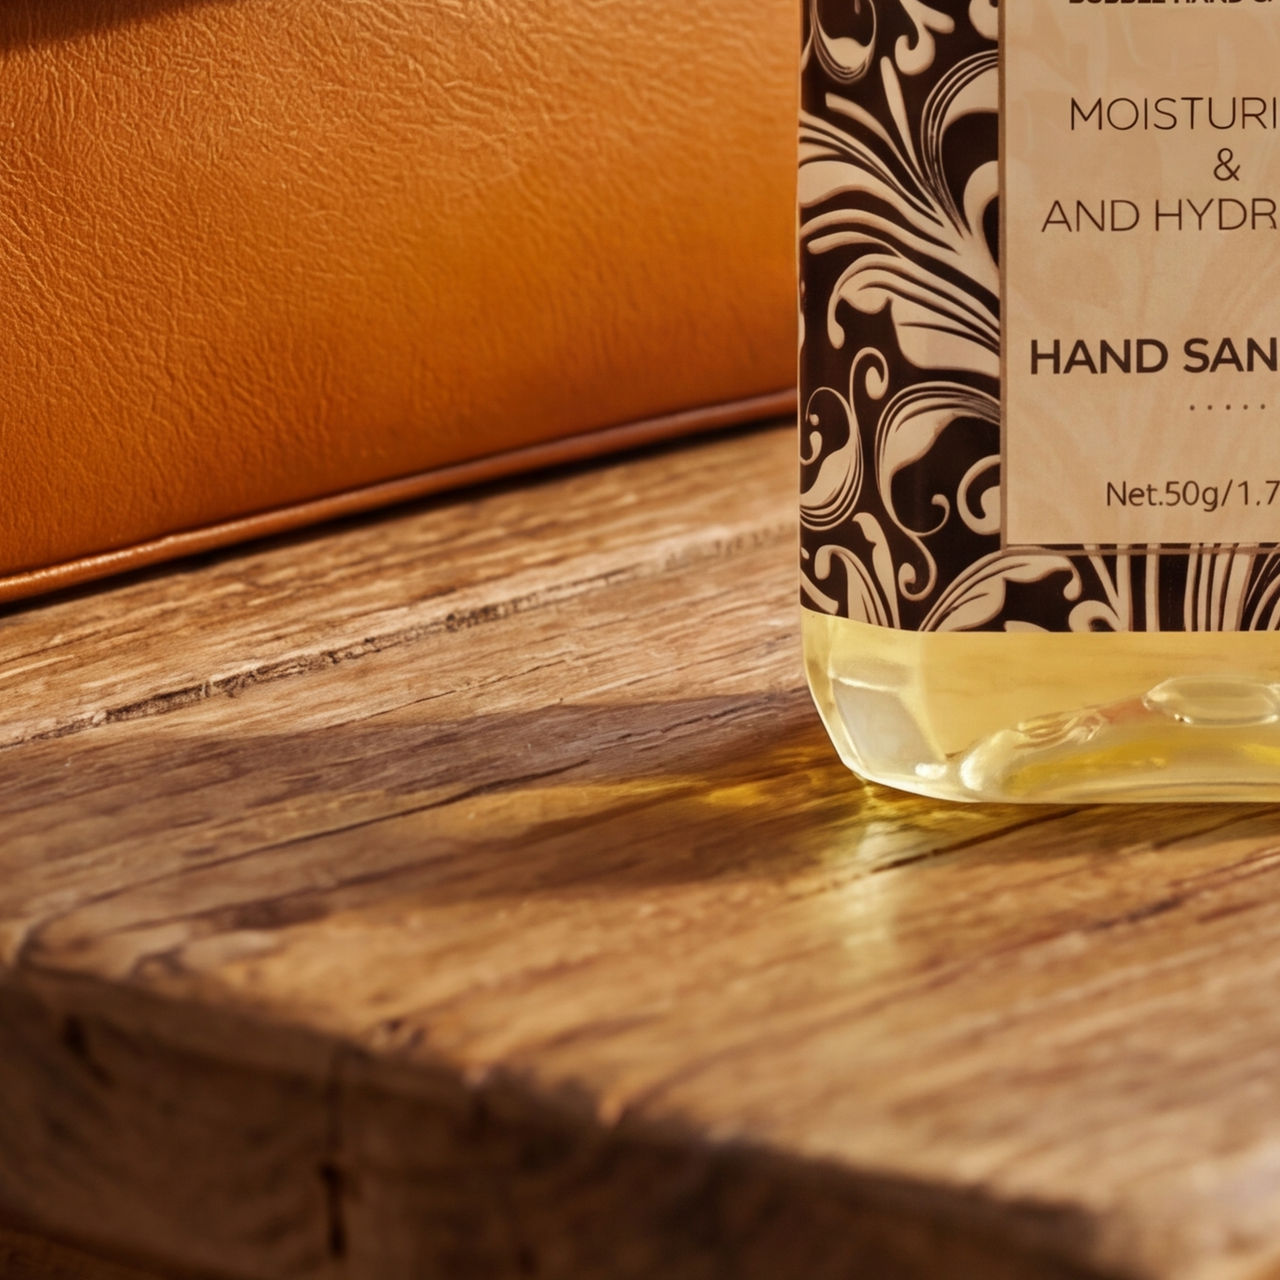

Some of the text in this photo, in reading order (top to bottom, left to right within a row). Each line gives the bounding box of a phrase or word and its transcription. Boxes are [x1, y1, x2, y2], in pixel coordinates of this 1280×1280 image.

[1213, 148, 1241, 182] &
[1041, 200, 1141, 233] AND
[1031, 339, 1169, 376] HAND
